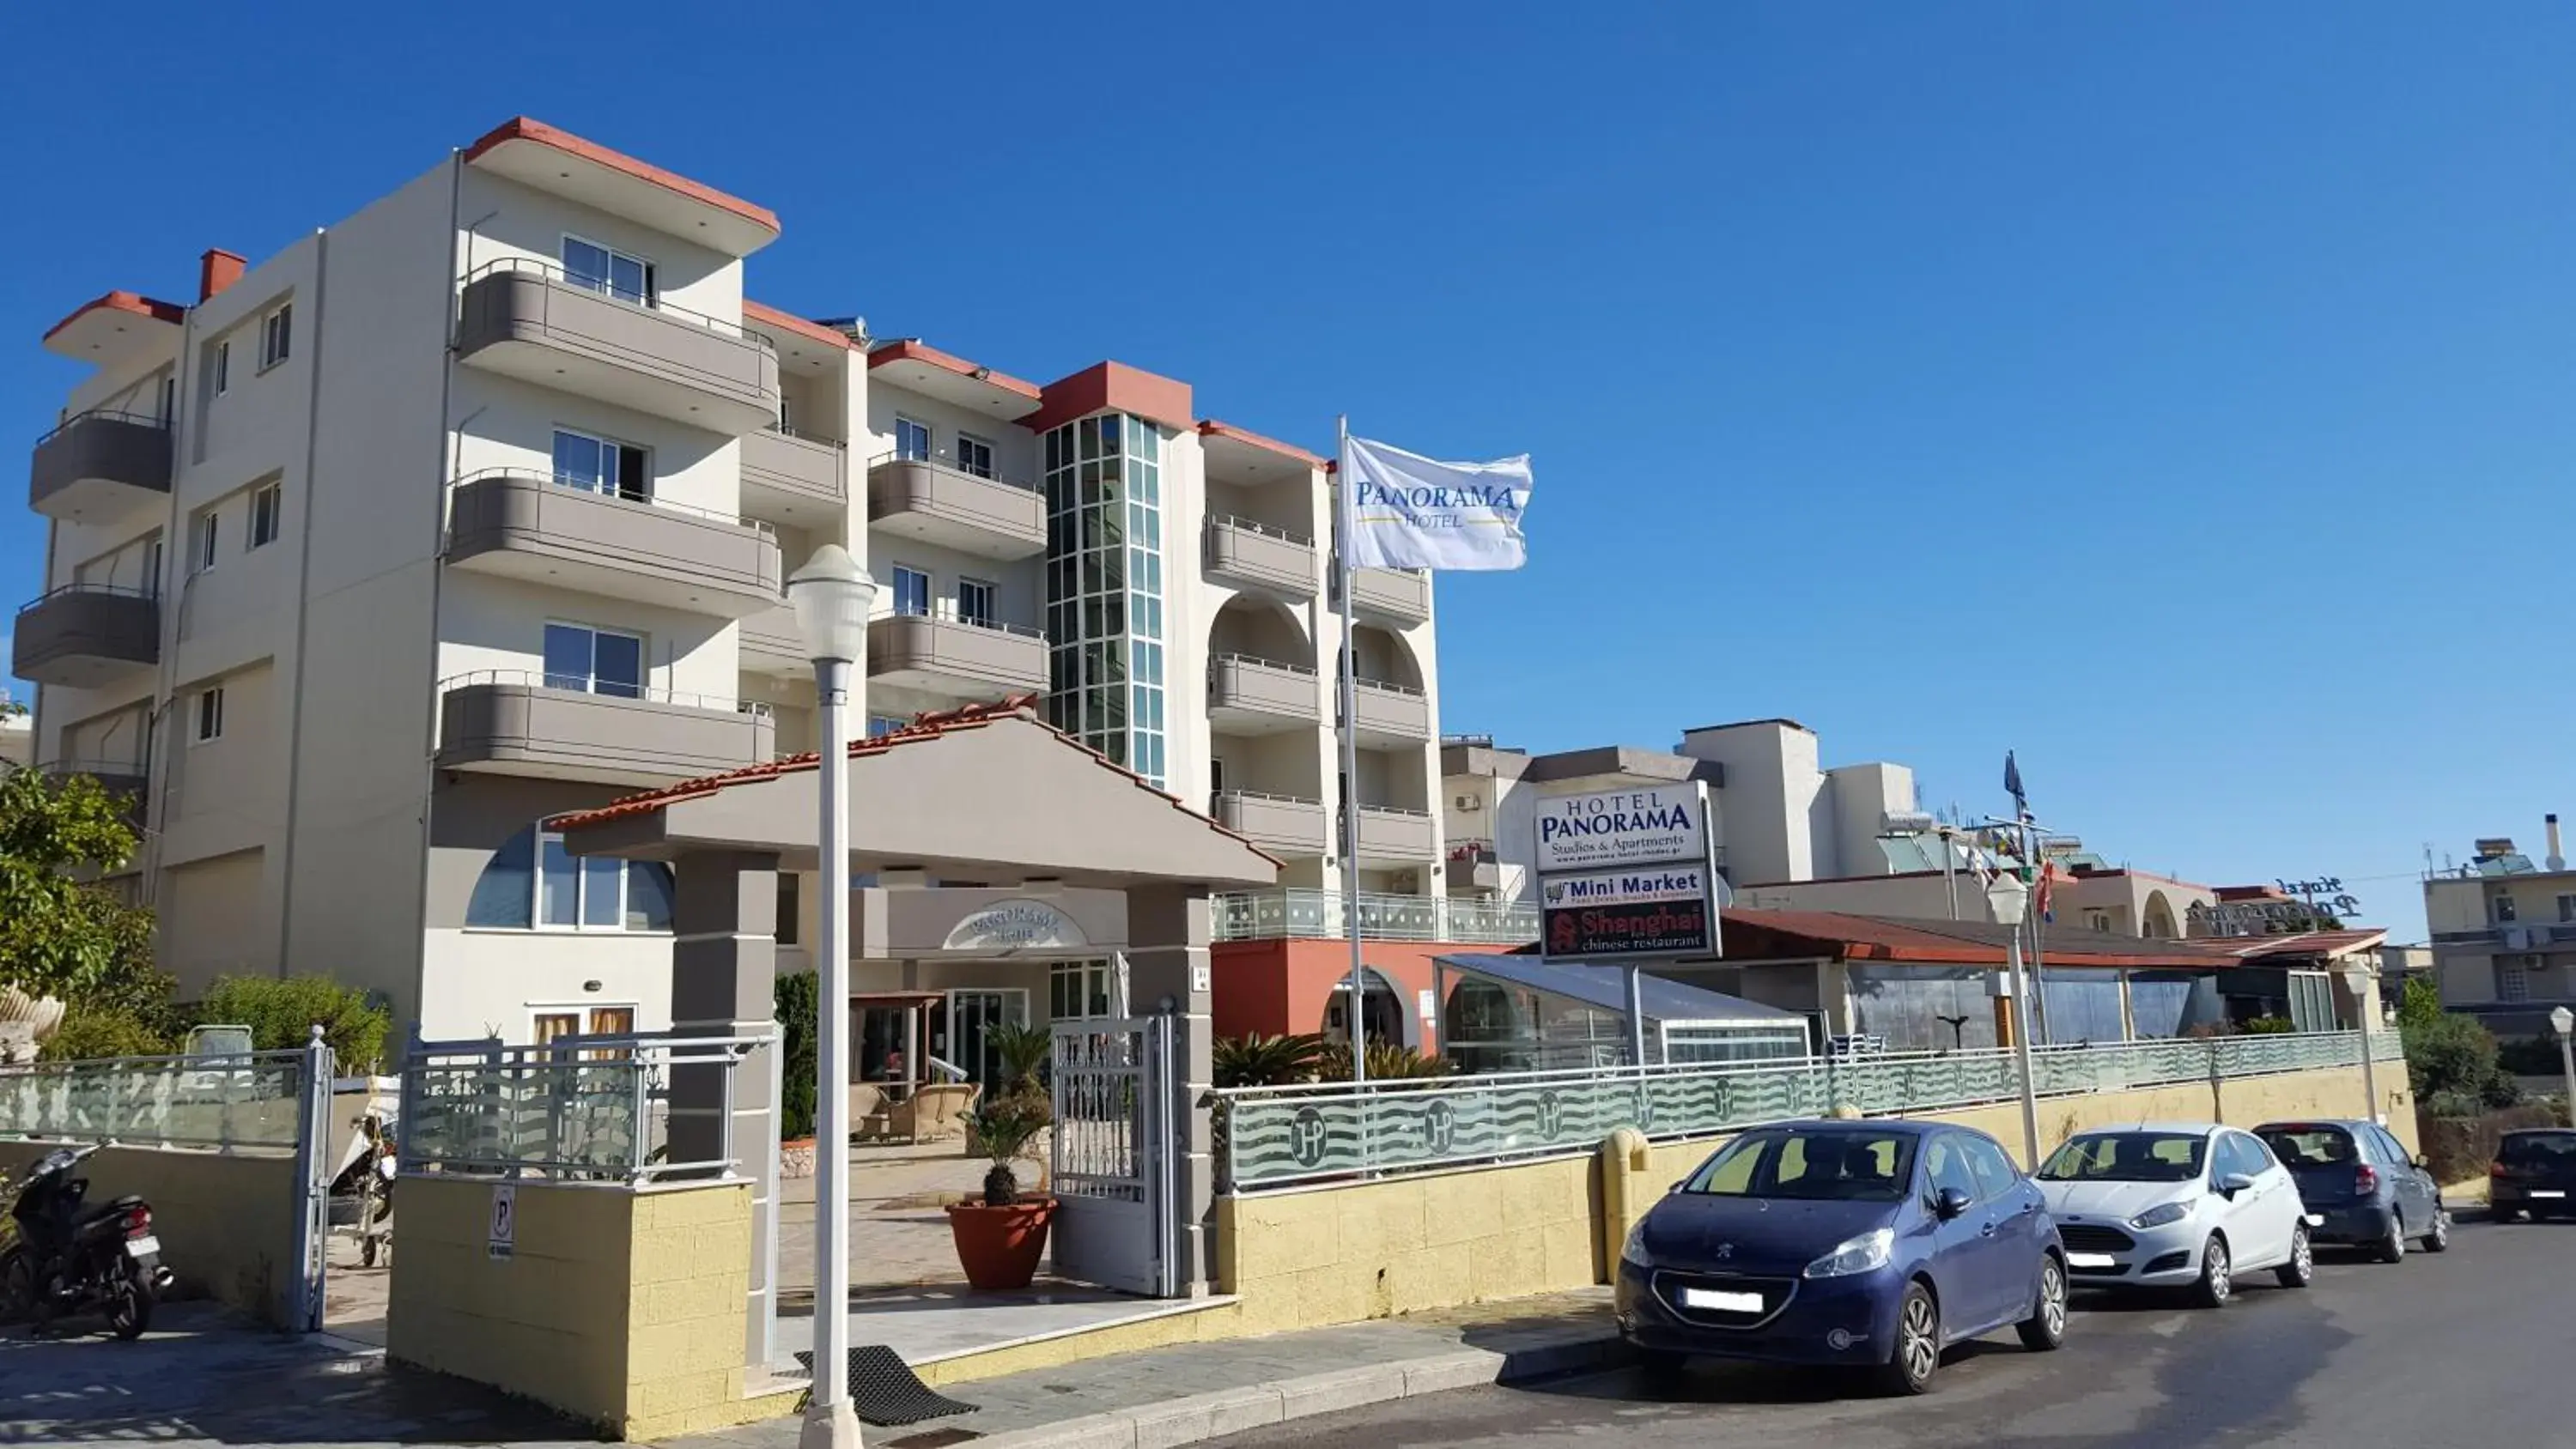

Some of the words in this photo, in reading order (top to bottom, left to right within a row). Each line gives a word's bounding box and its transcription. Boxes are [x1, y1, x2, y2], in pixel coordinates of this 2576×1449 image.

[1356, 482, 1517, 511] PANORAMA
[1404, 512, 1464, 529] HOTEL
[1566, 792, 1663, 815] HOTEL
[1542, 803, 1691, 843] PANORAMA
[1552, 841, 1595, 856] Studios
[1599, 841, 1608, 851] &
[1613, 834, 1685, 851] Apartments
[1571, 878, 1614, 896] Mini
[1623, 872, 1698, 894] Market
[1582, 906, 1702, 937] Shanghai
[1583, 937, 1631, 952] chinese
[1634, 935, 1700, 949] restaurant
[498, 1201, 507, 1226] P
